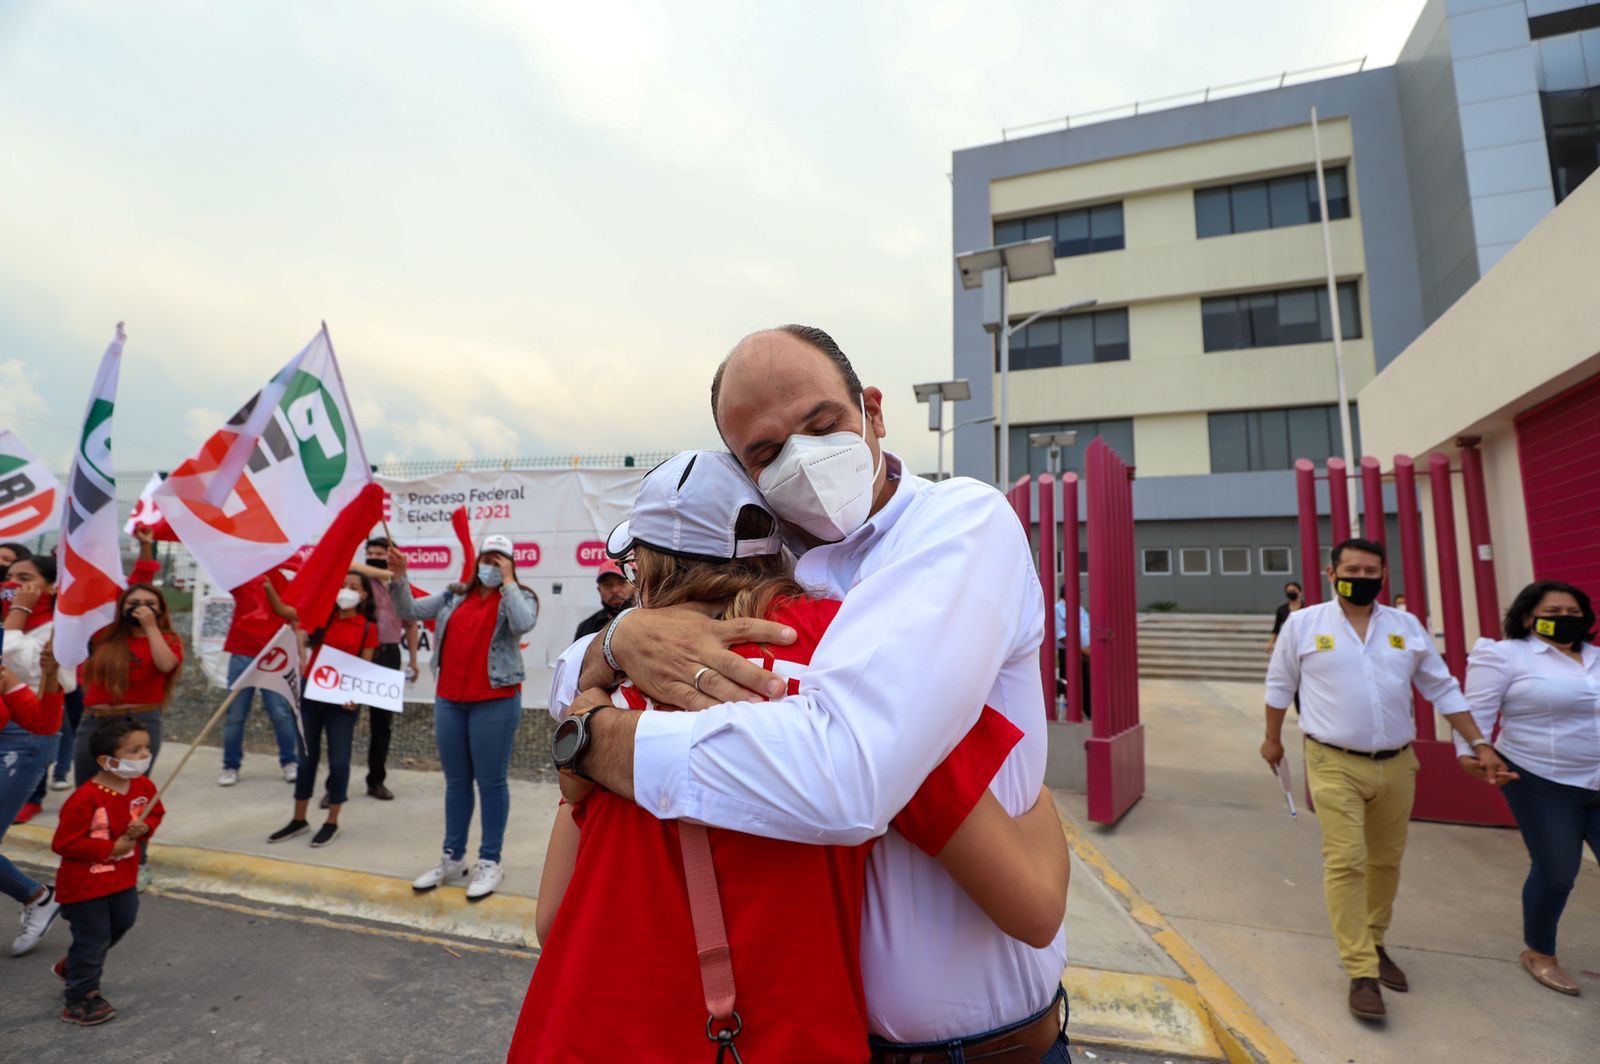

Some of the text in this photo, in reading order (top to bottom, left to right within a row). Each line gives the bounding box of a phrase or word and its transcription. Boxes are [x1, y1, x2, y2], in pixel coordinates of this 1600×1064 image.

[408, 485, 525, 504] Proceso Federal
[475, 503, 511, 520] 2021
